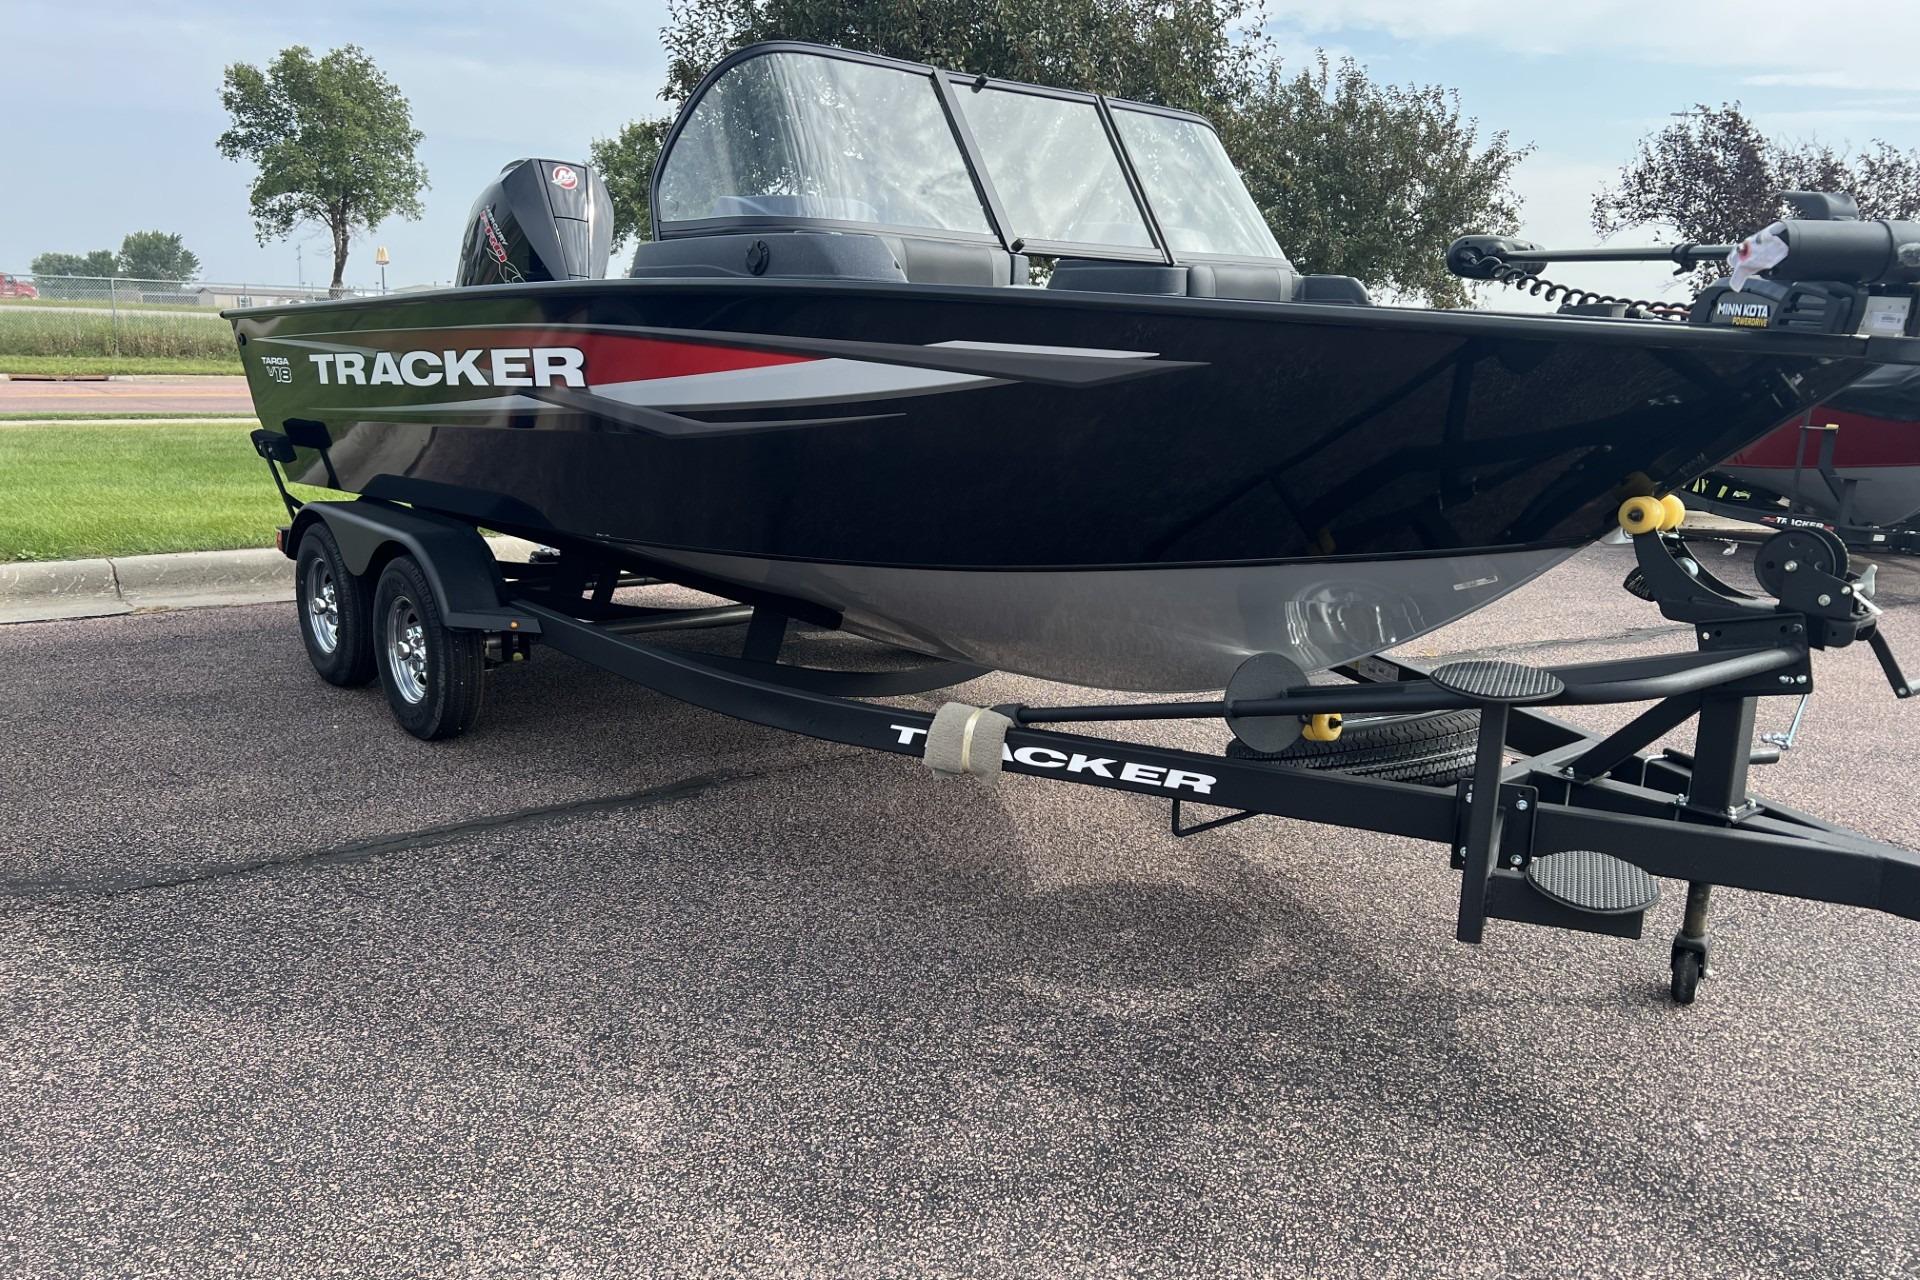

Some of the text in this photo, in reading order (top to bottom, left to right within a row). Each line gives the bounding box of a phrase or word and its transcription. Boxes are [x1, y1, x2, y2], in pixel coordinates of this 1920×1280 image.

[1716, 302, 1769, 318] MINN KOTA
[1732, 316, 1769, 328] POWERDRIVE
[260, 356, 290, 366] TARGA
[308, 346, 588, 389] TRACKER
[266, 365, 293, 383] V18
[889, 723, 1218, 795] TCKER
